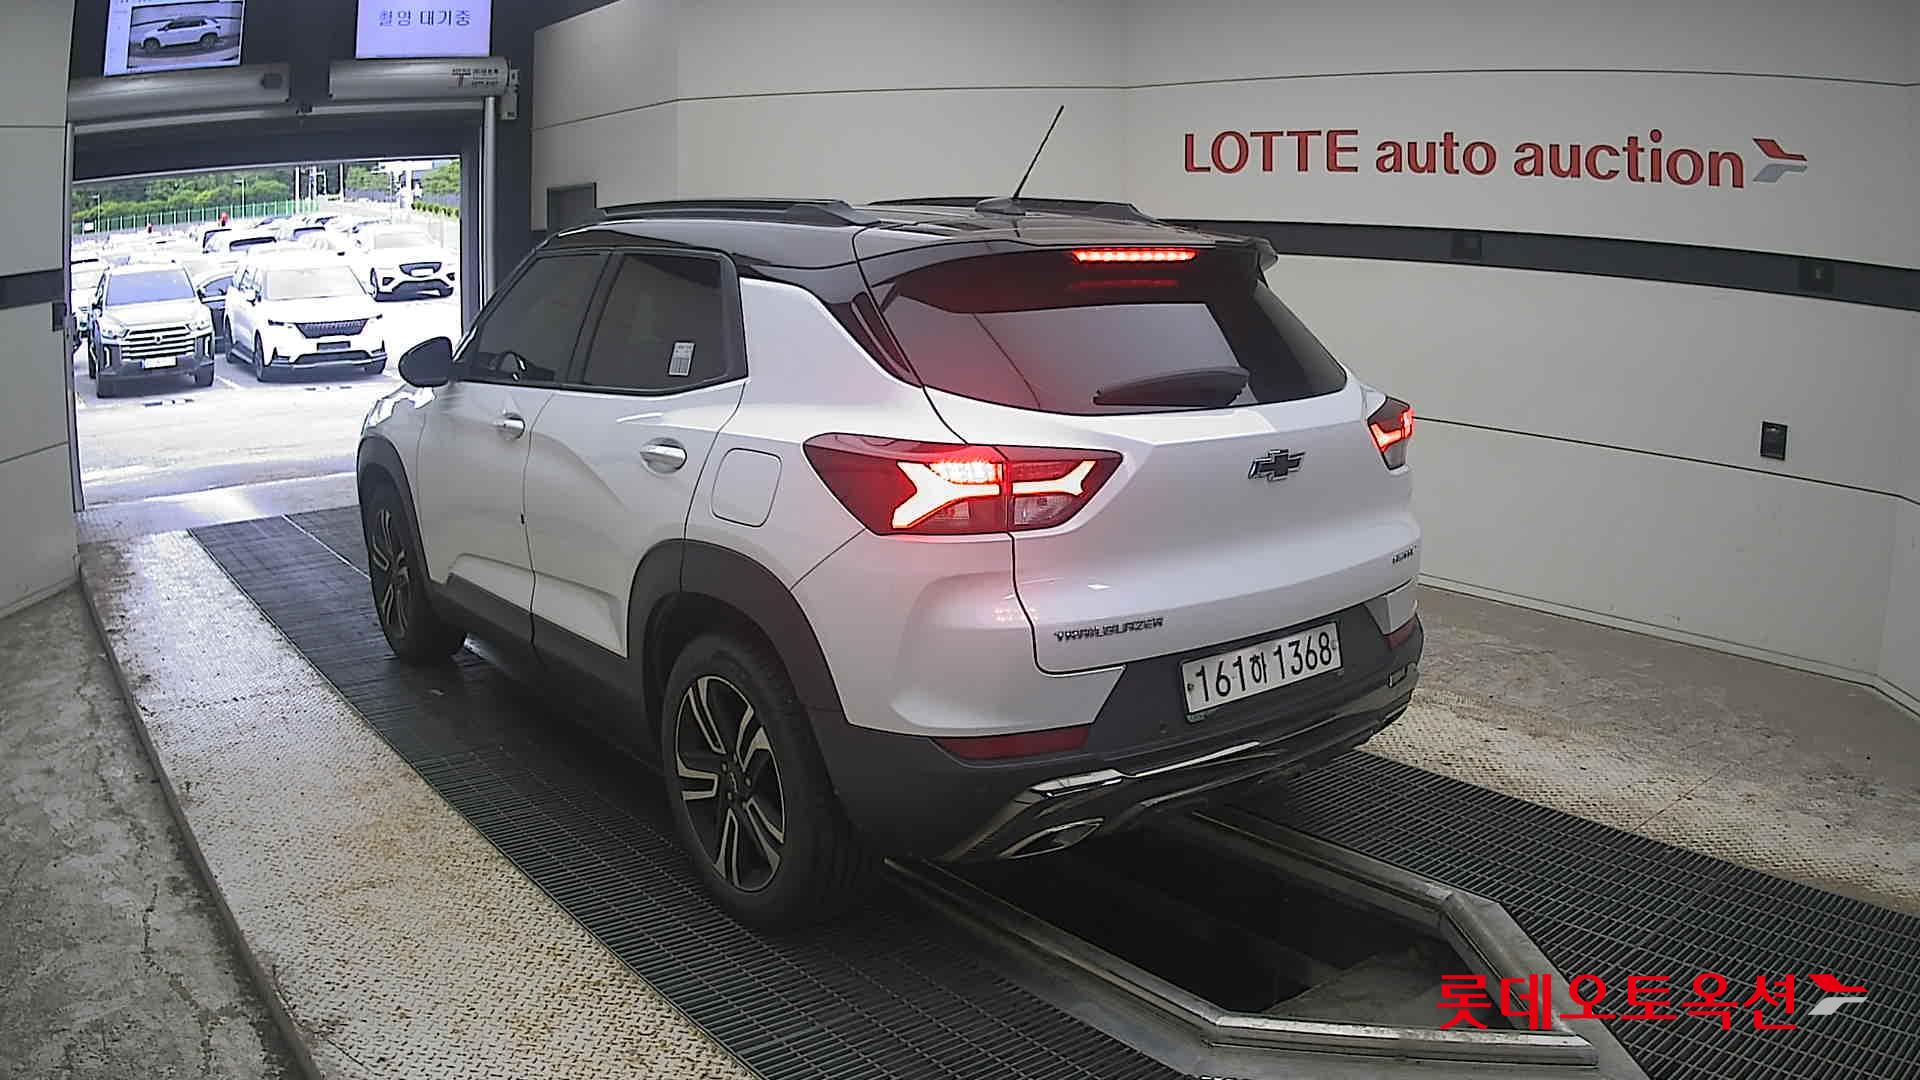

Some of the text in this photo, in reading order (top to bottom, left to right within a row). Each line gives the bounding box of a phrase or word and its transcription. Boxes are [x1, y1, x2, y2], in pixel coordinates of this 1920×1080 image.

[420, 9, 472, 26] 대기중
[1184, 128, 1745, 189] LOTTE auto auction
[1195, 631, 1332, 702] 161하 1368
